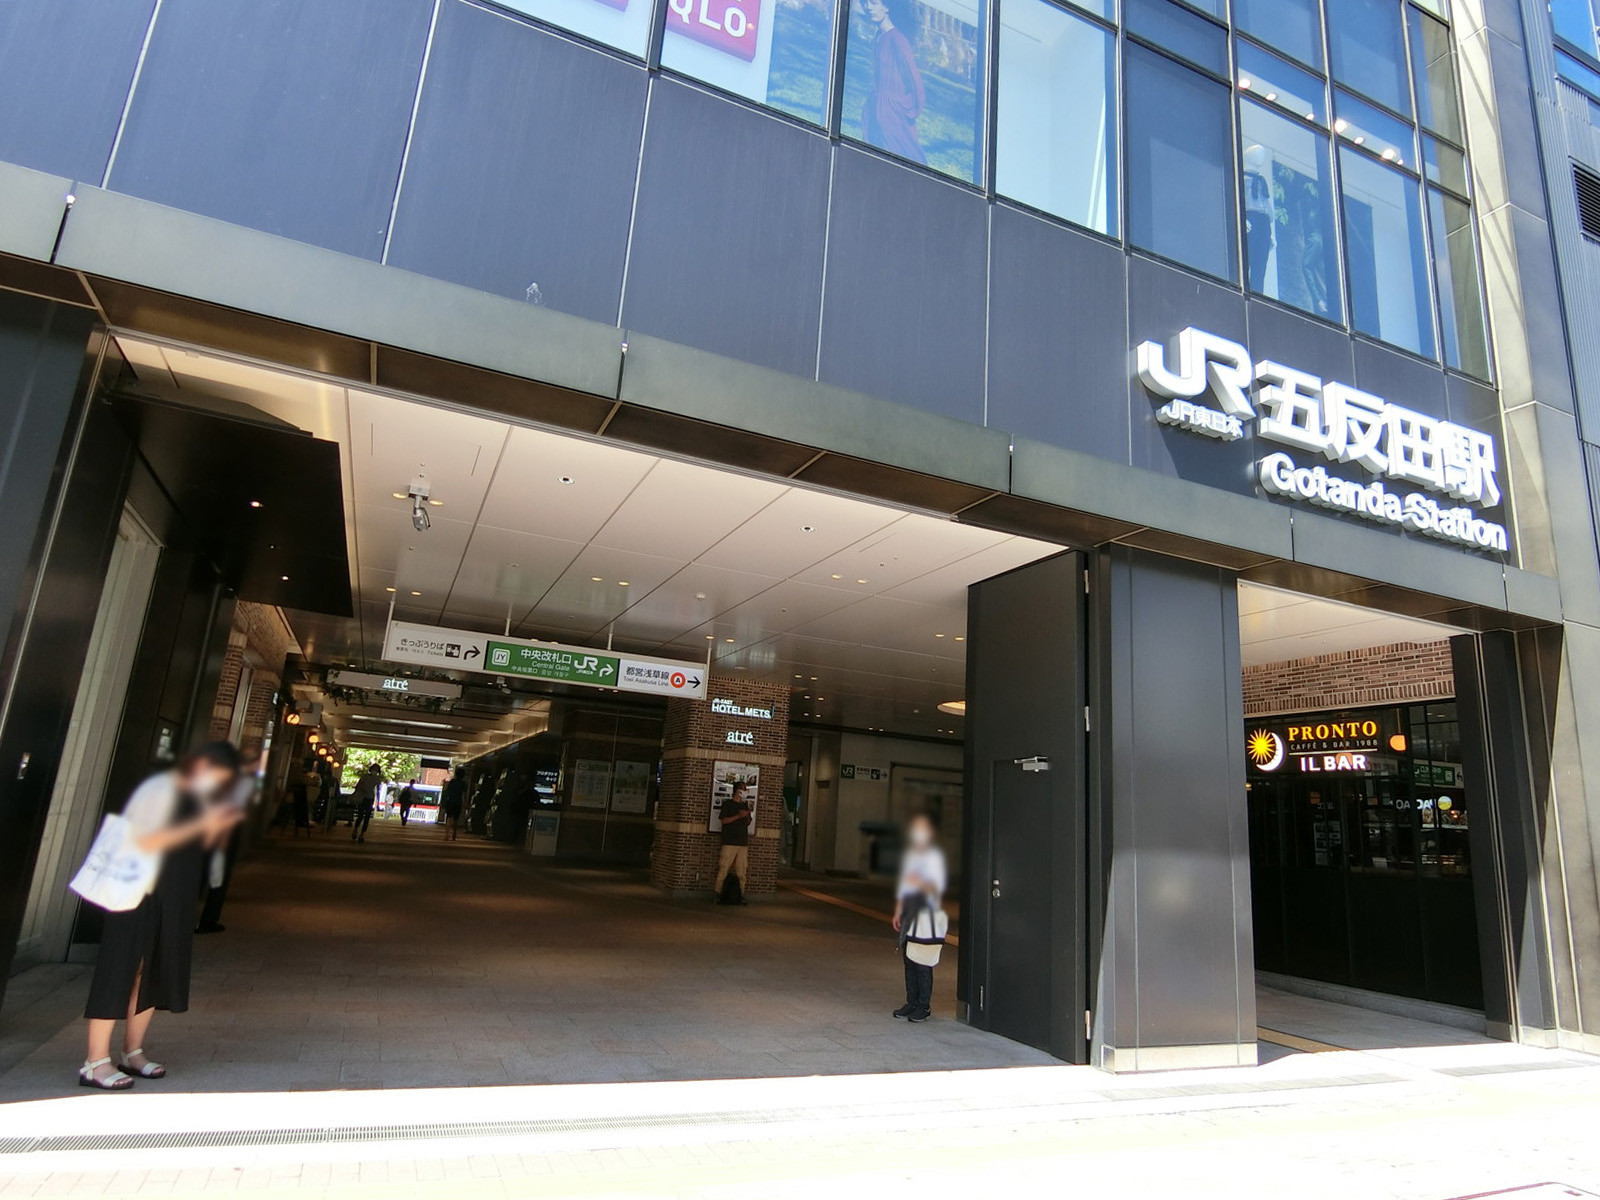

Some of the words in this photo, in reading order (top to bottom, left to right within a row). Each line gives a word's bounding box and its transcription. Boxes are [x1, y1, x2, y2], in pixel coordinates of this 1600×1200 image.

[1137, 326, 1257, 420] JR
[1254, 359, 1500, 509] 五反田駅
[1155, 399, 1243, 441] JR東日本
[1258, 452, 1403, 525] Gotanda
[1402, 491, 1508, 552] Station
[400, 638, 445, 650] きっぷうりば
[495, 651, 506, 661] JY
[521, 648, 572, 664] 中央改札口
[574, 656, 599, 671] JR
[532, 660, 554, 670] Central
[555, 663, 571, 672] Gate
[626, 666, 670, 680] 都営浅草線
[711, 703, 744, 716] HOTEL
[1287, 720, 1377, 741] PRONTO
[1356, 739, 1378, 747] 1988
[1301, 756, 1321, 772] IL
[1323, 754, 1366, 771] BAR
